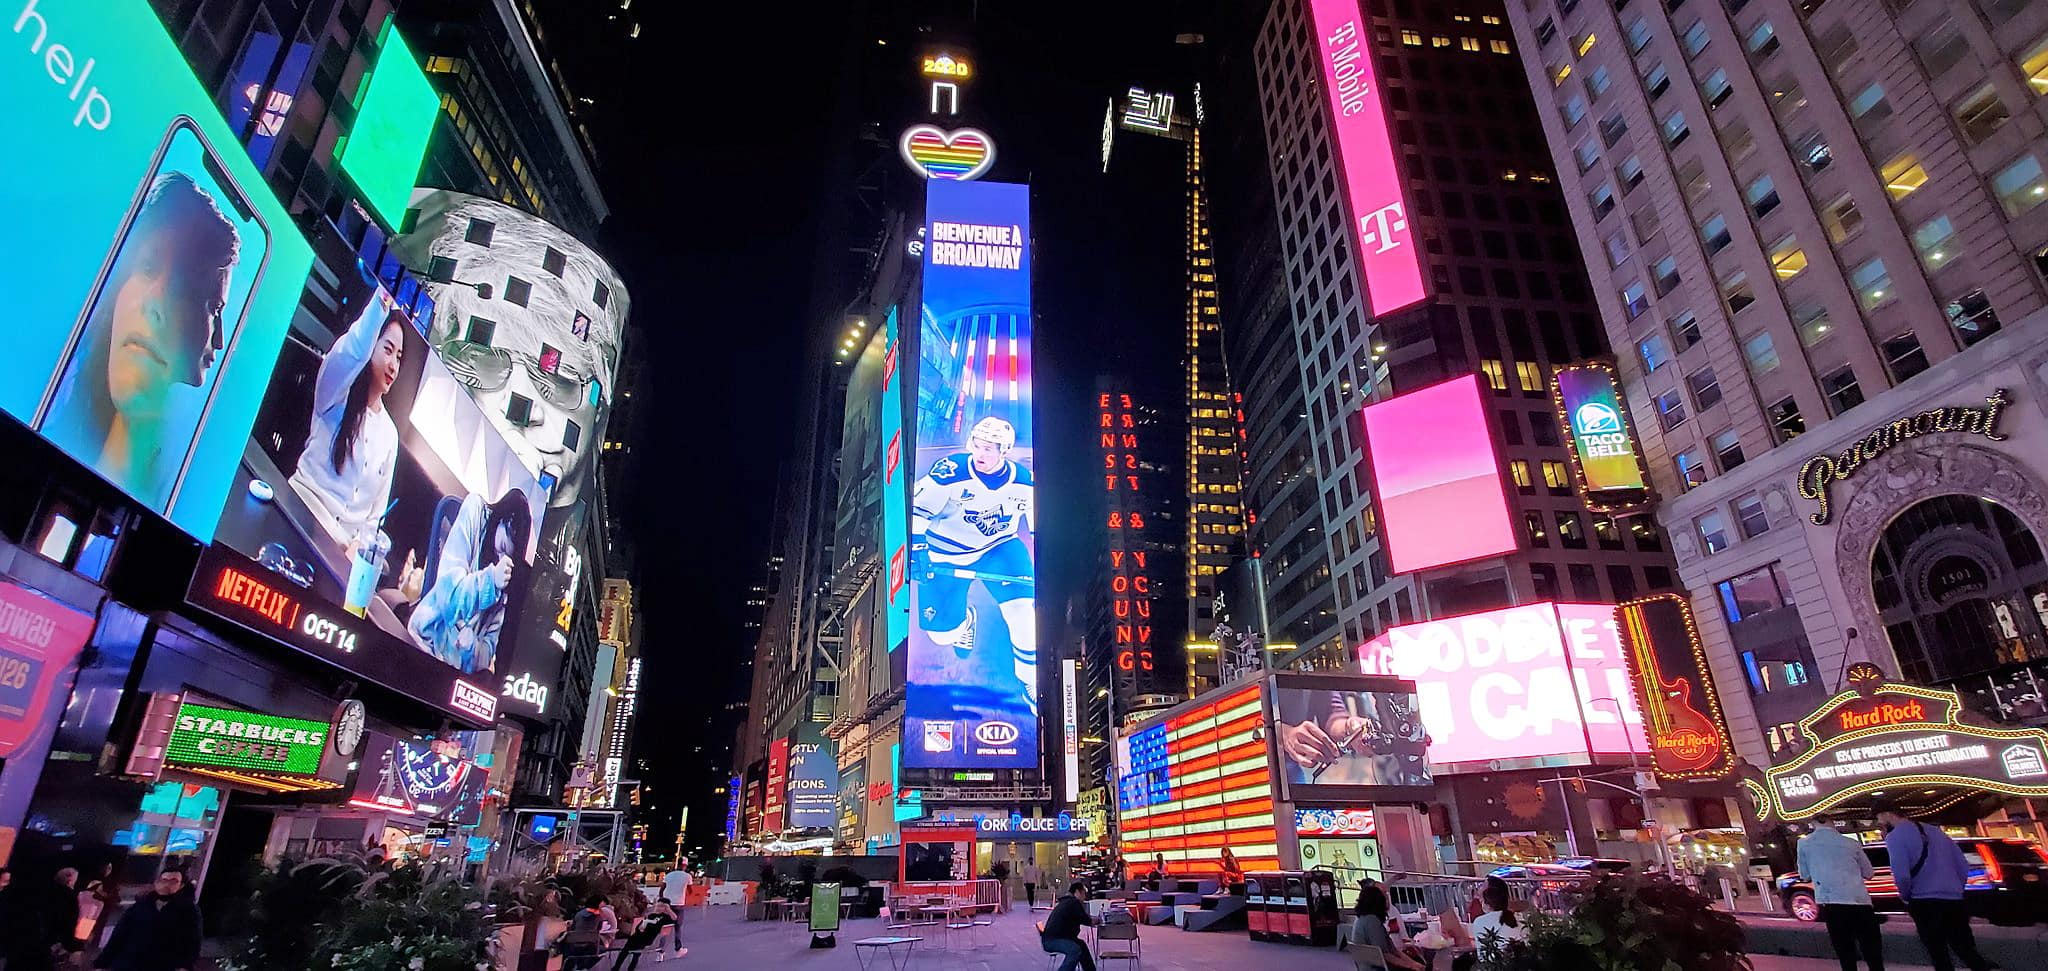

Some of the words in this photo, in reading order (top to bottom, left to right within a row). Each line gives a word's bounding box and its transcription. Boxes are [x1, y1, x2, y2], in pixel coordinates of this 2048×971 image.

[14, 0, 112, 130] help
[923, 57, 969, 77] 2020
[932, 221, 1011, 243] BIENVENUE
[1011, 224, 1023, 247] À
[1360, 201, 1405, 254] T
[931, 241, 1022, 270] BROADWAY
[1099, 393, 1118, 491] ERNST
[1579, 432, 1625, 447] TACO
[1587, 444, 1632, 458] BELL
[1797, 388, 2009, 526] Paramount
[1107, 511, 1122, 528] &
[1941, 568, 1972, 585] 1501
[217, 567, 289, 625] NETFLIX
[1111, 550, 1135, 671] YOUNG
[303, 613, 338, 644] OCT
[337, 629, 356, 653] 14
[1841, 707, 1880, 729] Hard
[1881, 699, 1924, 725] Rock
[177, 715, 323, 746] STARBUCKS
[982, 726, 1012, 740] KIA
[1657, 734, 1685, 749] Hard
[1686, 733, 1717, 748] Rock
[198, 737, 290, 762] COFFEE
[1680, 747, 1699, 755] CAFE
[973, 812, 1009, 832] YORK
[1010, 812, 1054, 832] POLICE
[1057, 812, 1091, 832] DEPT
